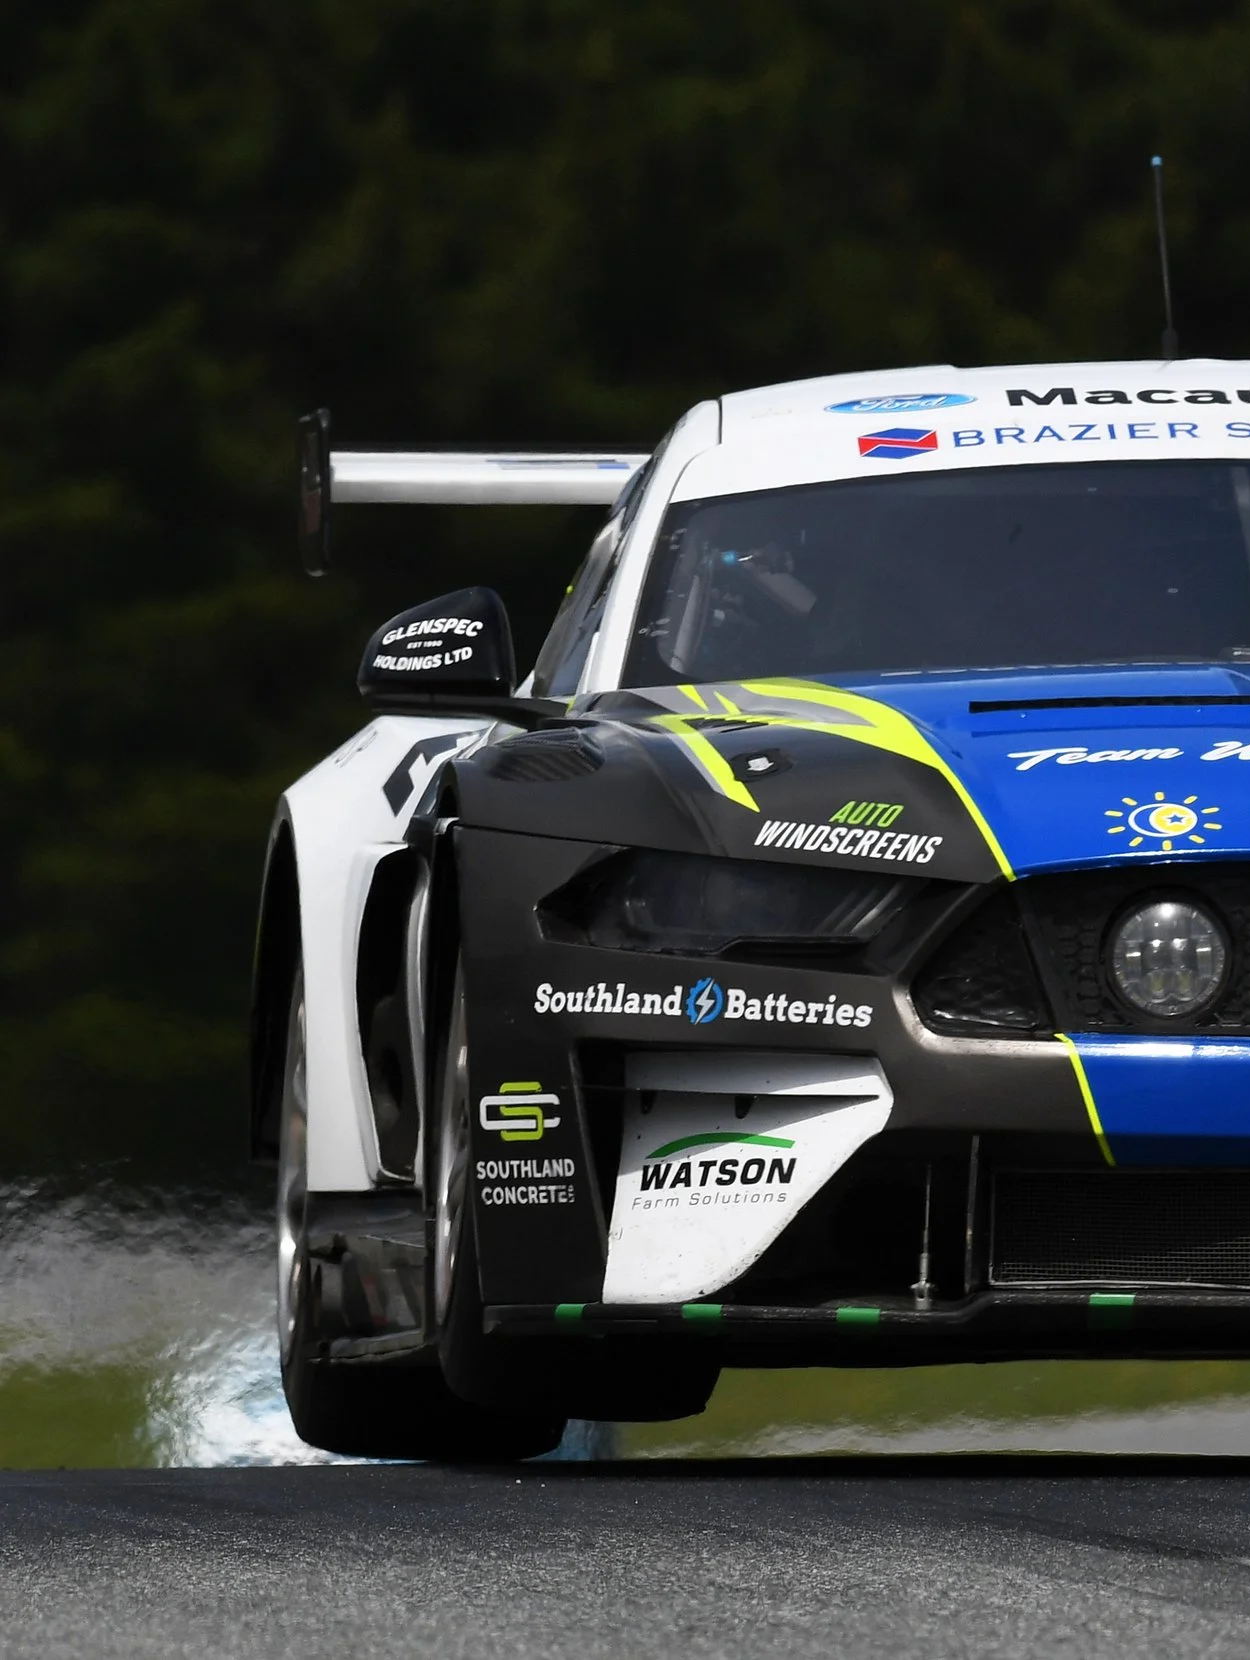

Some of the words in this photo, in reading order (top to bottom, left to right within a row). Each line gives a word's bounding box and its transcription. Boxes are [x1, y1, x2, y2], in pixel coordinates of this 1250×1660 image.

[953, 421, 1200, 448] BRAZIER
[382, 618, 483, 645] GLENSPEC
[373, 653, 442, 672] HOLDINGS
[444, 646, 473, 666] LTD
[1007, 744, 1185, 772] Team
[828, 800, 905, 828] AUTO
[753, 819, 944, 864] WINDSCREENS
[533, 982, 682, 1017] Southland
[724, 988, 874, 1028] Batteries
[476, 1158, 575, 1180] SOUTHLAND
[640, 1157, 797, 1192] WATSON
[481, 1185, 568, 1206] CONCRETE
[632, 1196, 680, 1211] Farm
[688, 1190, 788, 1207] Solutions
